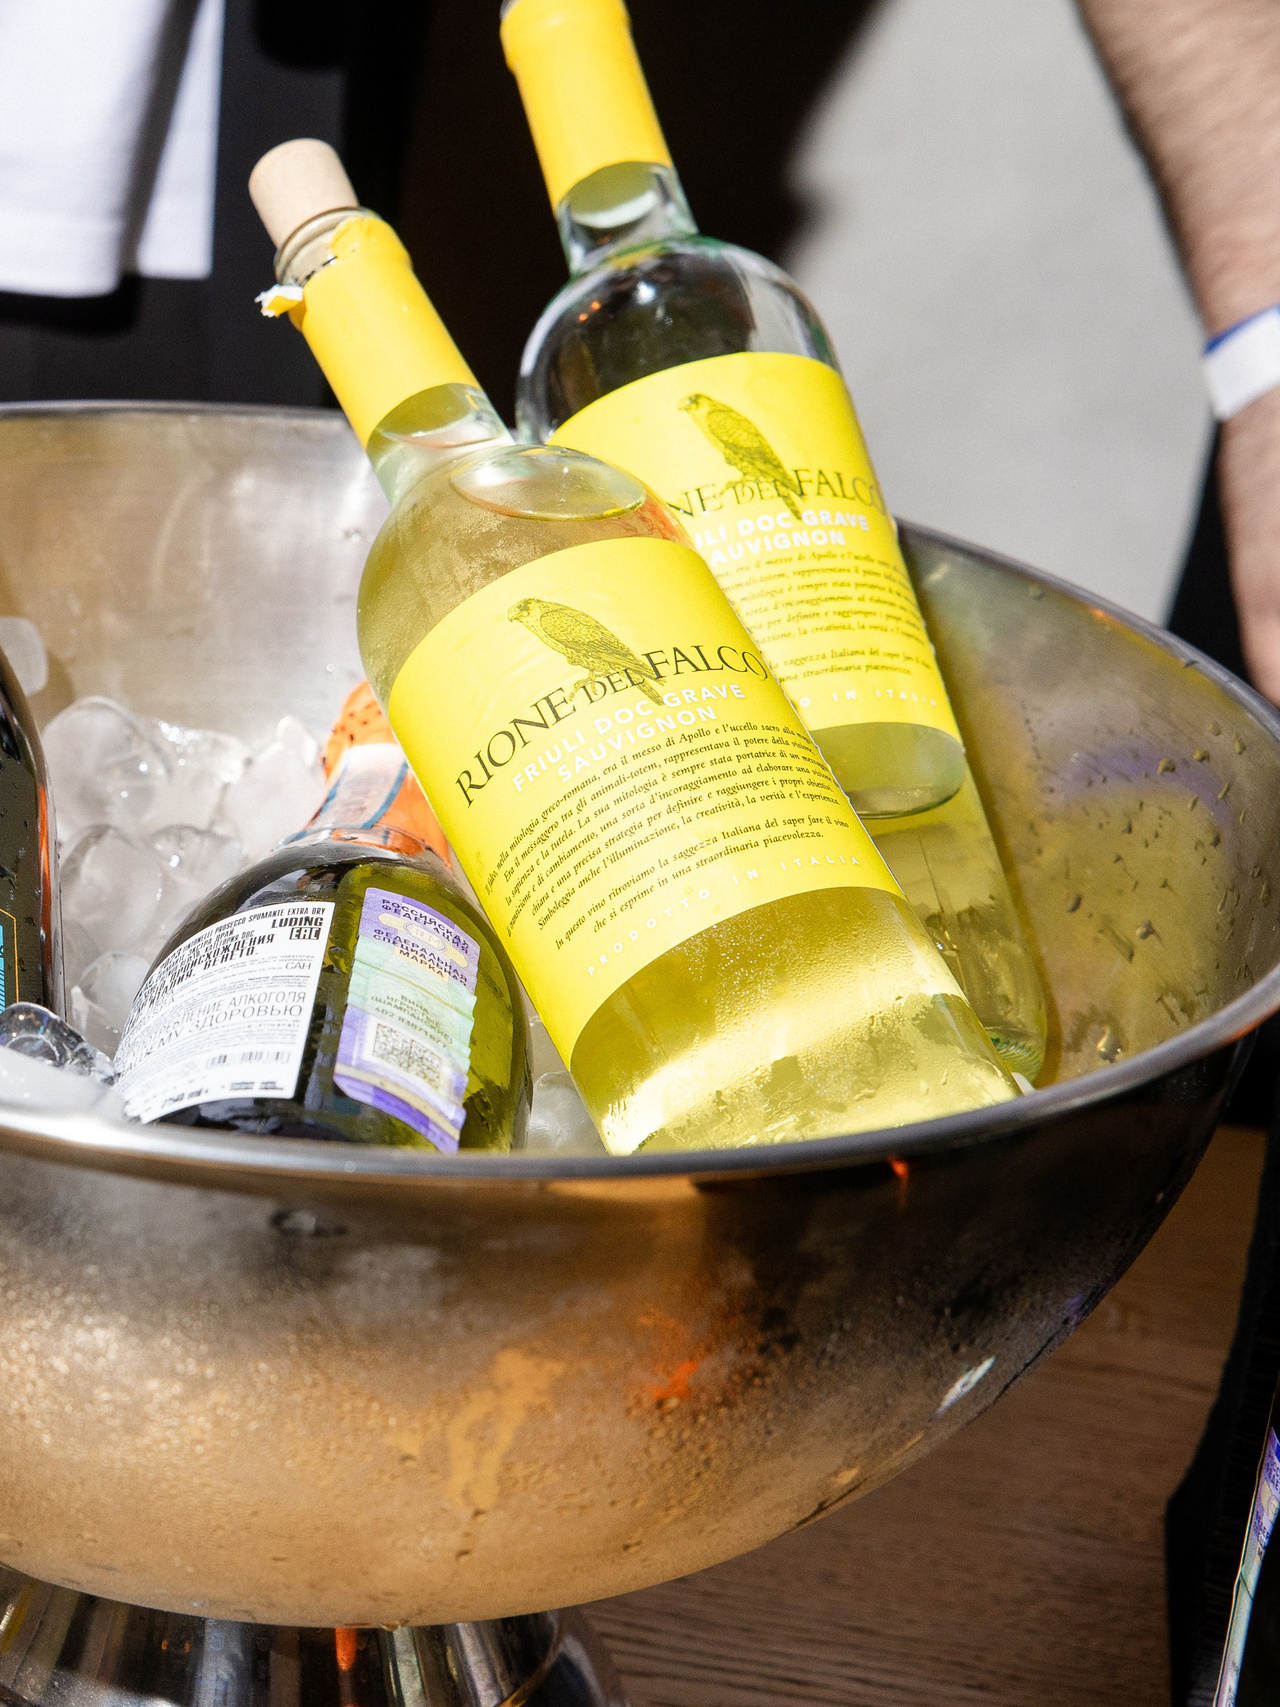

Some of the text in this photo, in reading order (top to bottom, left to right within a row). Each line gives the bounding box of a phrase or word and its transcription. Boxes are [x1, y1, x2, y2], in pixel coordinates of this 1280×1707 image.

[711, 530, 845, 566] AUVIGNON
[737, 510, 870, 536] DOC GRAVE
[455, 687, 577, 808] RIONE
[580, 667, 645, 704] DEL
[642, 643, 769, 682] FALCO
[512, 683, 745, 793] FRIULI DOC GRAVE
[556, 704, 718, 783] SAUVIGNON
[833, 690, 856, 702] IN
[504, 869, 515, 882] Era
[515, 859, 521, 869] il
[521, 822, 559, 860] messaggero
[561, 809, 573, 821] tra
[576, 797, 587, 814] gli
[591, 762, 662, 802] animali-totem,
[663, 737, 730, 765] rappresentava
[733, 737, 740, 746] il
[744, 736, 769, 748] potere
[771, 736, 790, 746] della
[505, 896, 511, 906] la
[511, 866, 535, 899] sapienza
[542, 850, 550, 860] la
[550, 830, 576, 850] tutela.
[577, 816, 590, 830] La
[594, 804, 610, 819] sua
[613, 778, 658, 806] mitologia
[662, 772, 668, 782] è
[671, 761, 706, 779] sempre
[709, 755, 732, 767] stata
[736, 750, 777, 764] portatrice
[779, 750, 788, 758] di
[789, 753, 801, 761] un
[509, 818, 539, 851] mitologia
[541, 774, 601, 822] greco-romana,
[603, 764, 617, 776] era
[621, 755, 628, 766] il
[632, 743, 661, 761] messo
[666, 736, 675, 747] di
[678, 728, 710, 744] Apollo
[722, 722, 758, 733] l'uccello
[761, 724, 780, 732] sacro
[532, 884, 537, 892] e
[537, 875, 545, 887] di
[545, 833, 599, 878] cambiamento,
[600, 818, 618, 833] una
[621, 803, 646, 819] sorta
[650, 770, 737, 805] d'incoraggiamento
[741, 765, 753, 775] ad
[756, 763, 793, 773] elaborare
[532, 893, 550, 916] chiara
[551, 885, 555, 893] e
[556, 870, 575, 888] una
[573, 848, 602, 874] precisa
[605, 821, 643, 850] strategia
[647, 812, 662, 828] per
[666, 794, 703, 815] definire
[716, 780, 770, 797] raggiungere
[772, 777, 776, 785] i
[779, 777, 804, 787] propri
[537, 887, 576, 930] Simboleggia
[578, 865, 601, 888] anche
[602, 820, 681, 869] l'illuminazione,
[682, 816, 692, 826] la
[696, 798, 745, 820] creatività,
[746, 796, 757, 805] la
[759, 791, 786, 802] verità
[555, 815, 849, 951] In questo vino ritroviamo la saggezza Italiana del saper fare il vino
[593, 829, 824, 934] che si esprime in una straordinaria piacevolezza.
[249, 909, 285, 922] SPUMANTE
[287, 908, 309, 916] EXTRA
[271, 916, 324, 929] LUDING
[374, 929, 468, 983] ФЕДЕРАЛЬНАЯ
[382, 899, 469, 949] РОССИЙСКАЯ
[399, 950, 444, 978] МАРКА
[588, 856, 860, 977] PRODOTTO IN ITALIA
